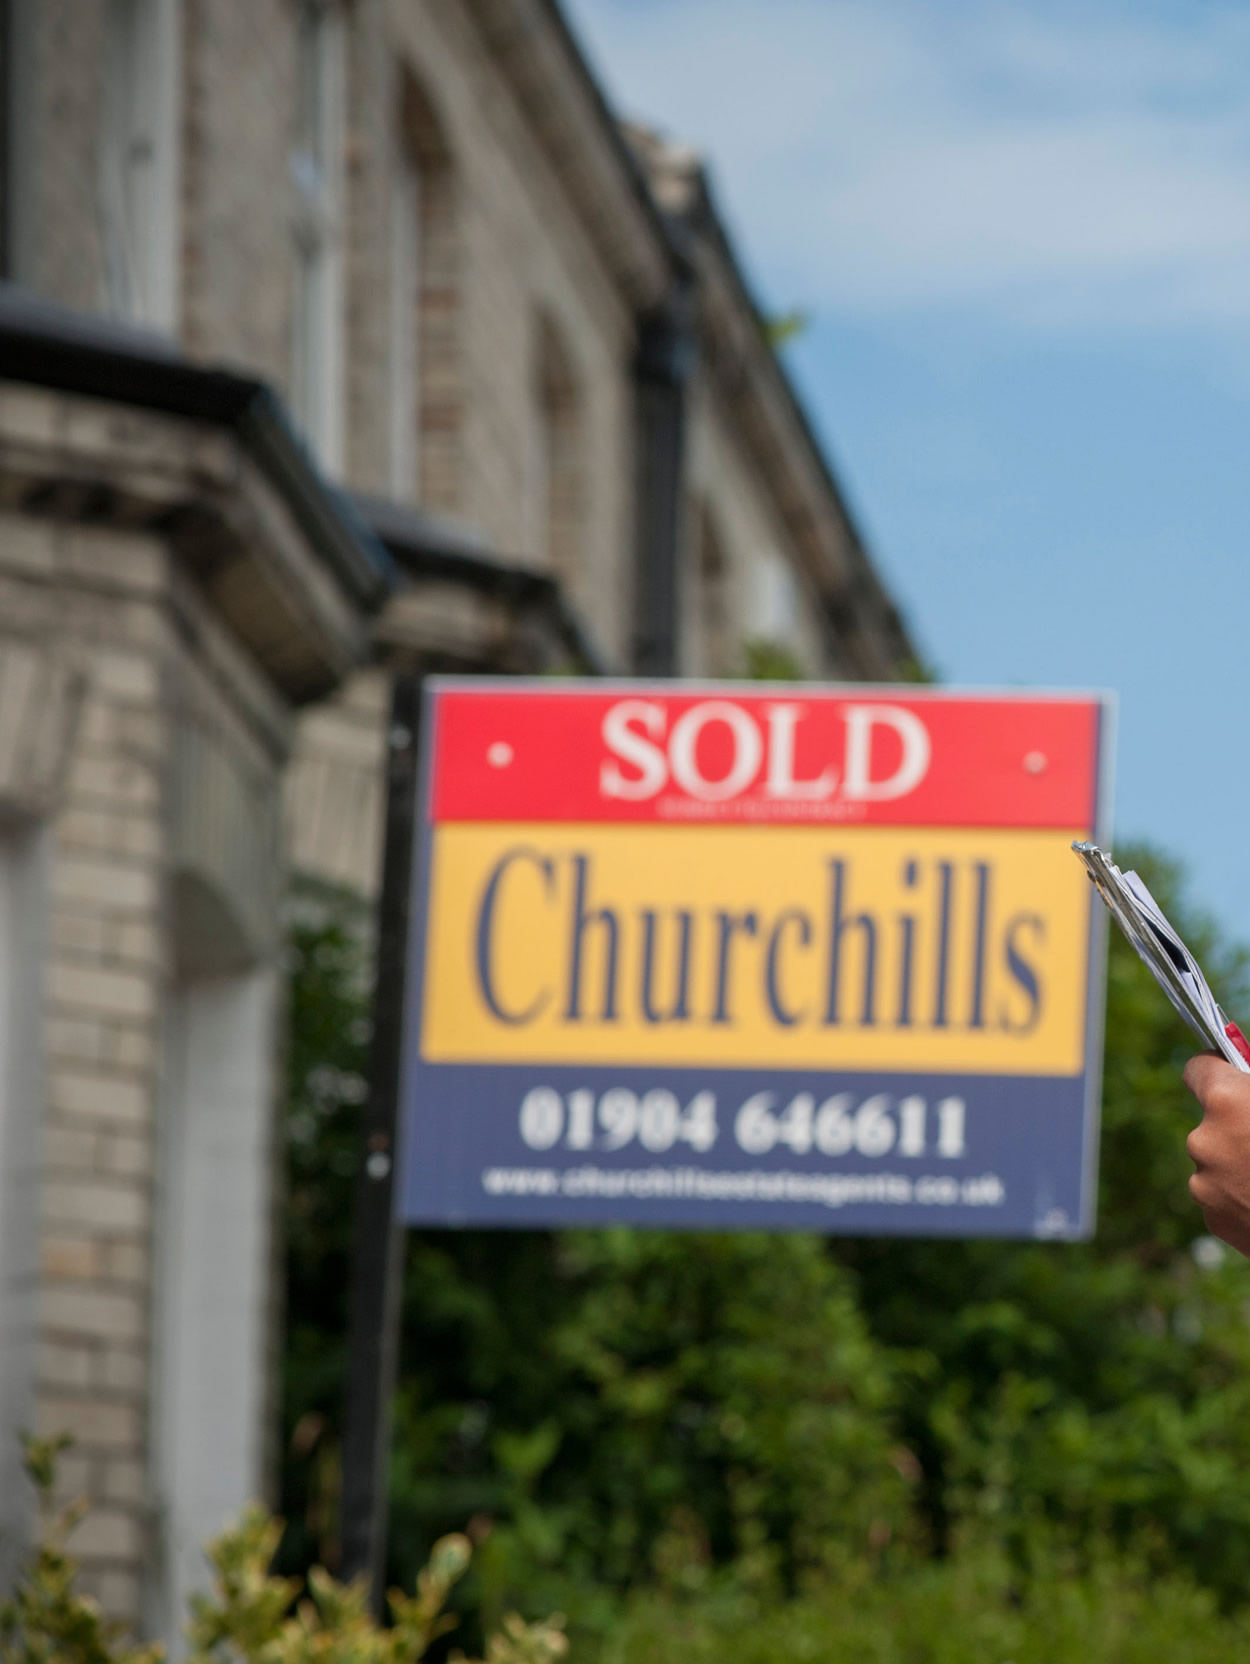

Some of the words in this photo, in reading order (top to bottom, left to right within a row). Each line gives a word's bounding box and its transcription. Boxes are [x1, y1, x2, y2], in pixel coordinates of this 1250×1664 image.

[600, 699, 931, 802] SOLD
[472, 845, 1048, 1039] Churchills
[519, 1085, 717, 1153] 01904
[734, 1090, 967, 1158] 646611
